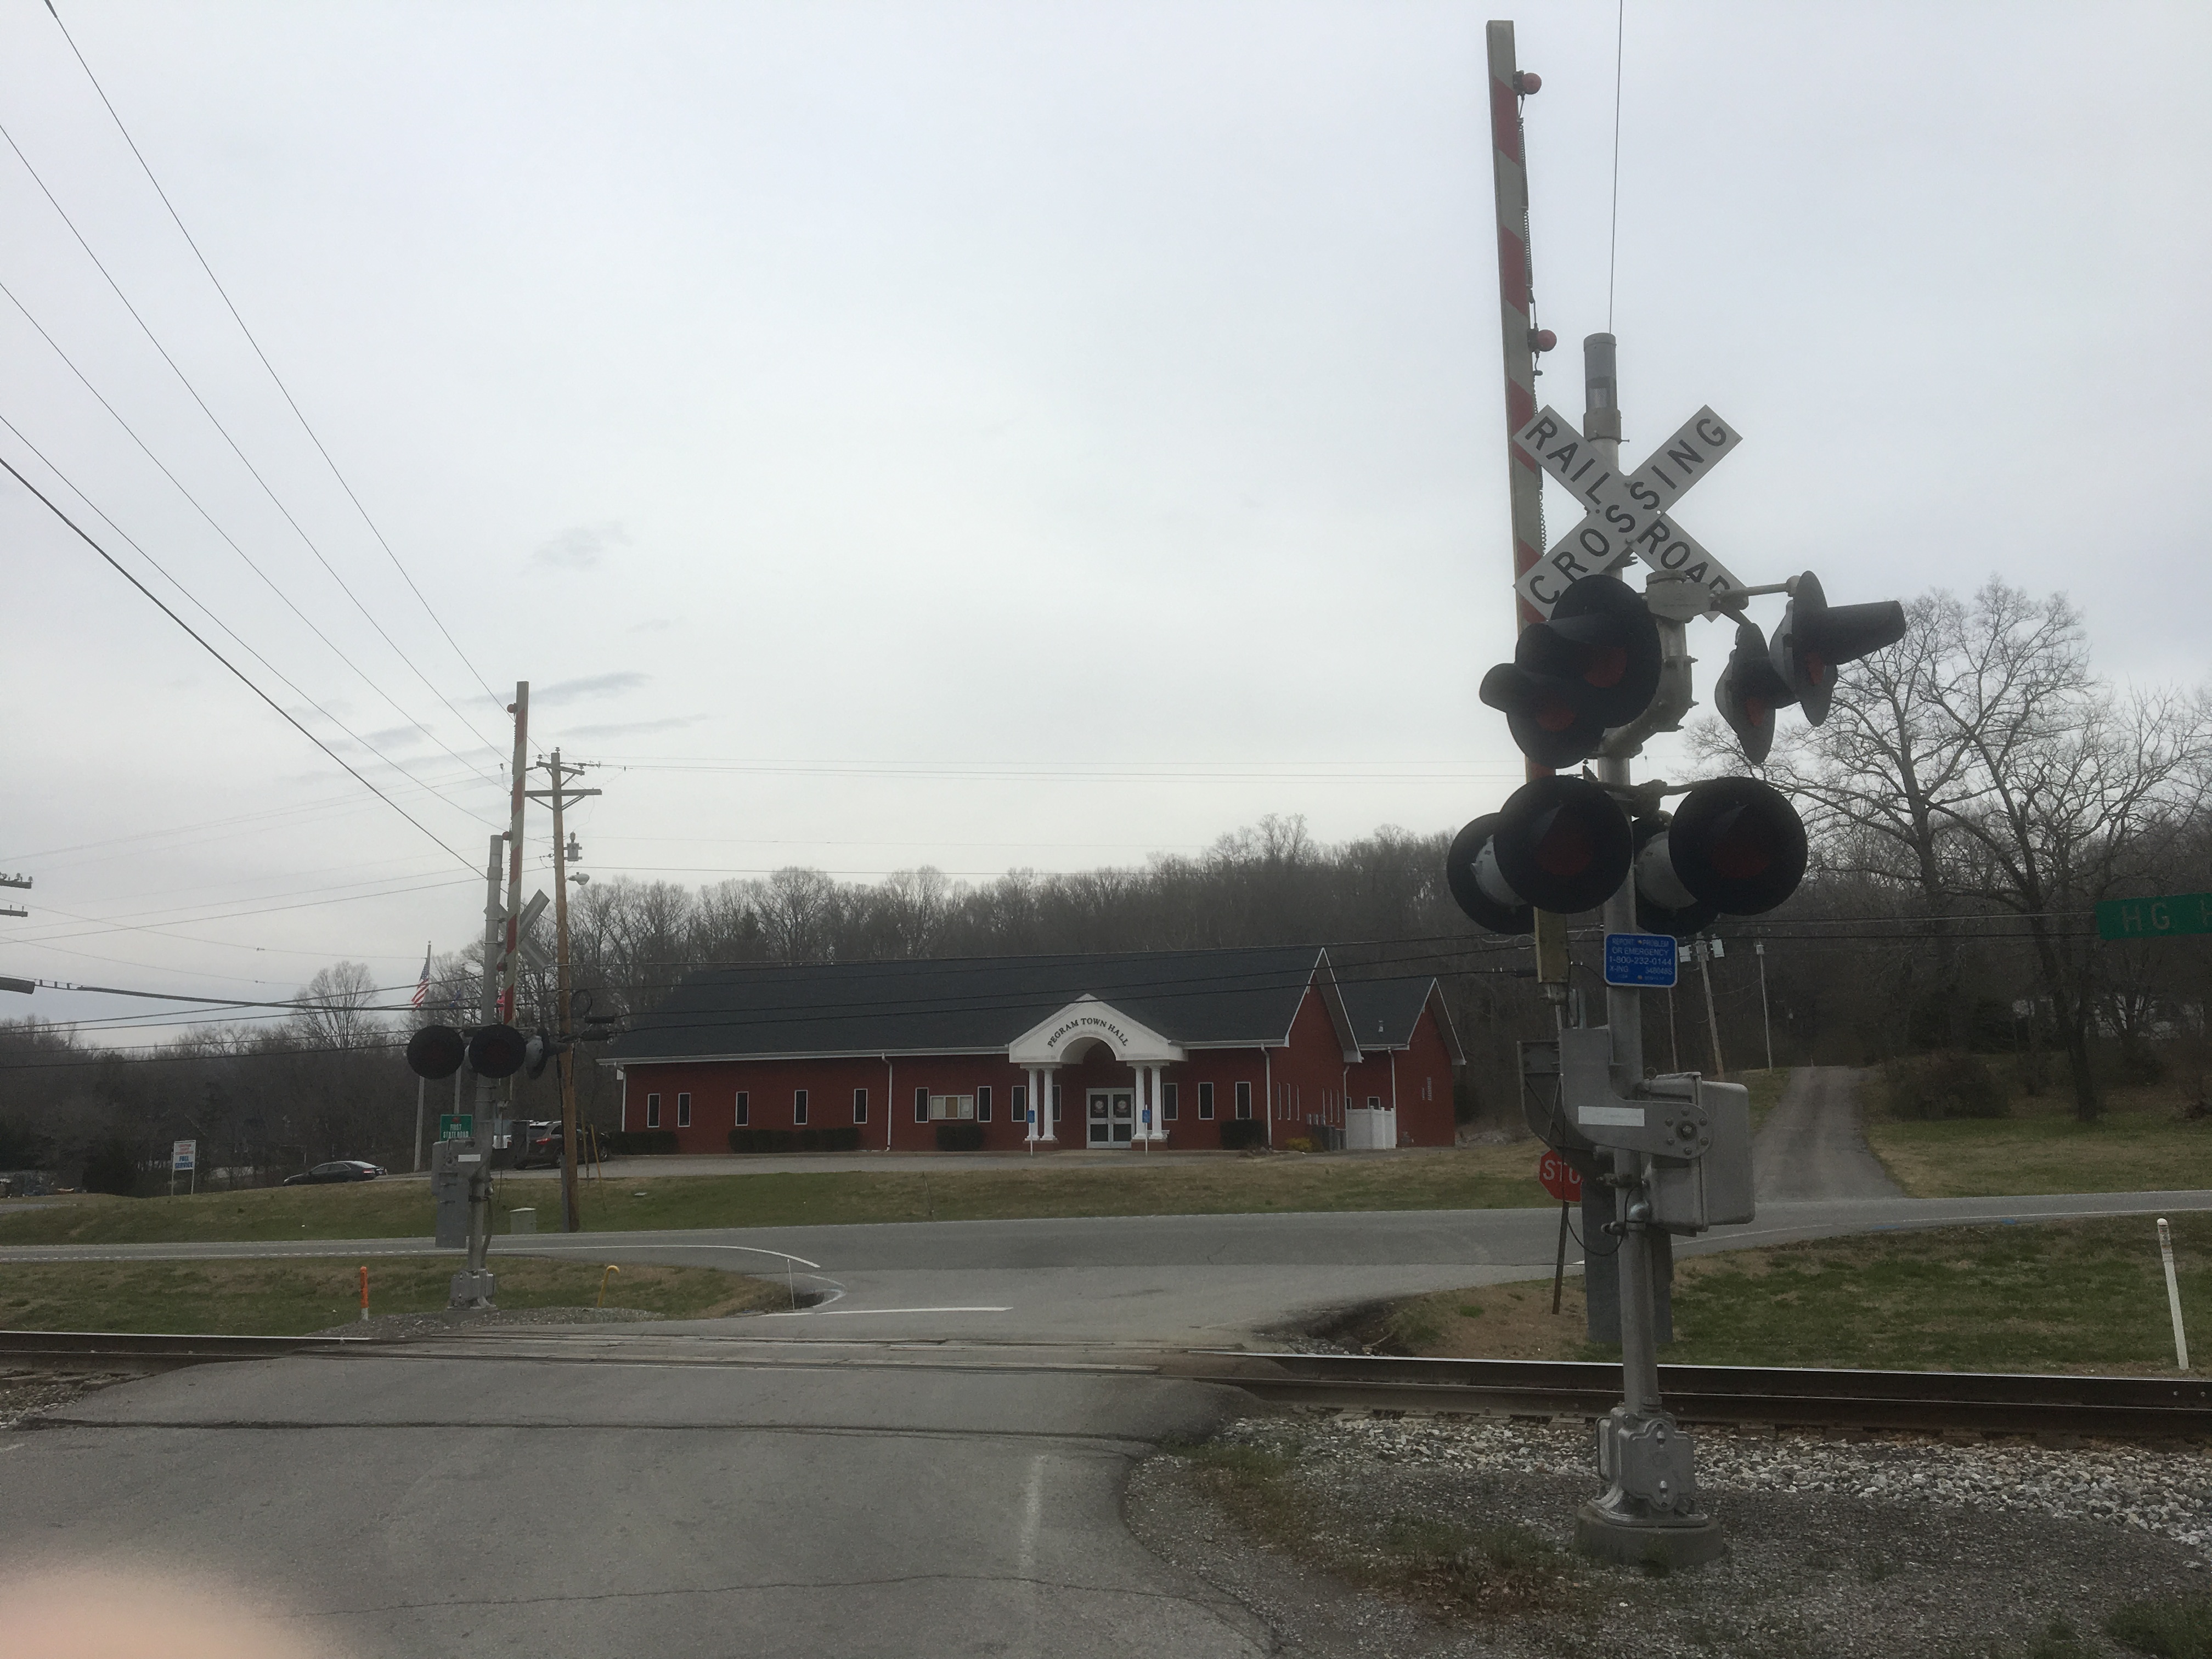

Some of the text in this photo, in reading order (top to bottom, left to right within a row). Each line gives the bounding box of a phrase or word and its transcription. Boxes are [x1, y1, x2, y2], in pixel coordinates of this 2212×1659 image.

[1525, 415, 1611, 505] RAIL
[1529, 418, 1728, 604] CROSSING
[2121, 902, 2170, 932] HG
[1624, 948, 1669, 956] EMERGENCY
[1642, 939, 1669, 947] PROBLEM
[1609, 956, 1672, 966] 1-800-232-0144
[1047, 1018, 1128, 1048] PEGRAM TOWN HALL
[1543, 1159, 1581, 1184] STO
